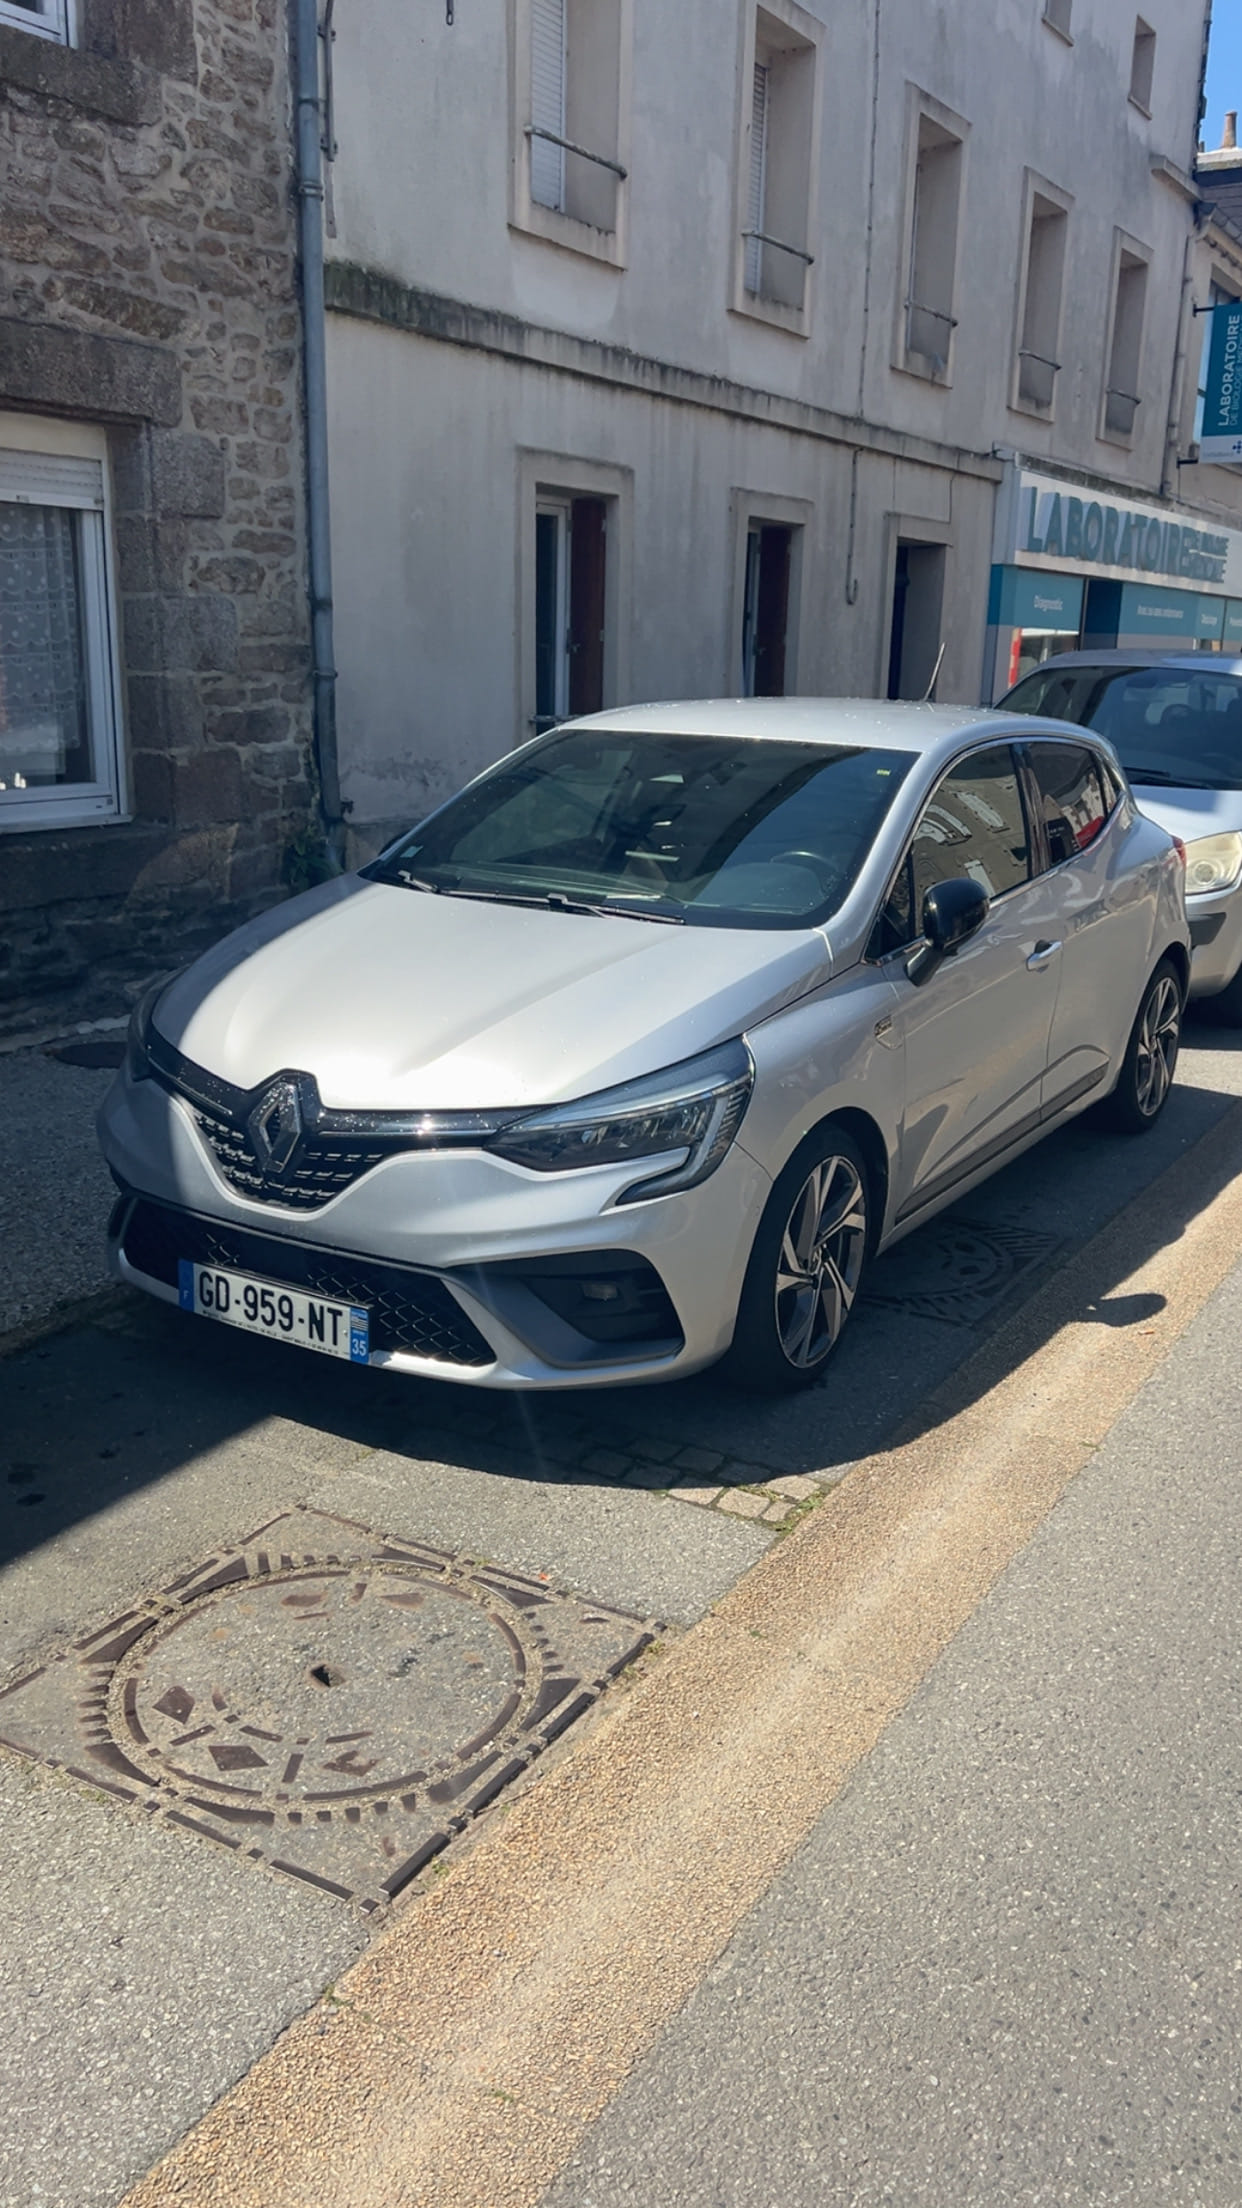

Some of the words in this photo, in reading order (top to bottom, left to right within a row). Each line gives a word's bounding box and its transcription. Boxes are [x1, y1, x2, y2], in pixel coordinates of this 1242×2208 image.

[1218, 314, 1241, 426] LABORATOIRE
[1026, 486, 1196, 578] LABORATOIRE
[200, 1271, 343, 1346] GD-959-NT
[352, 1338, 366, 1357] 35
